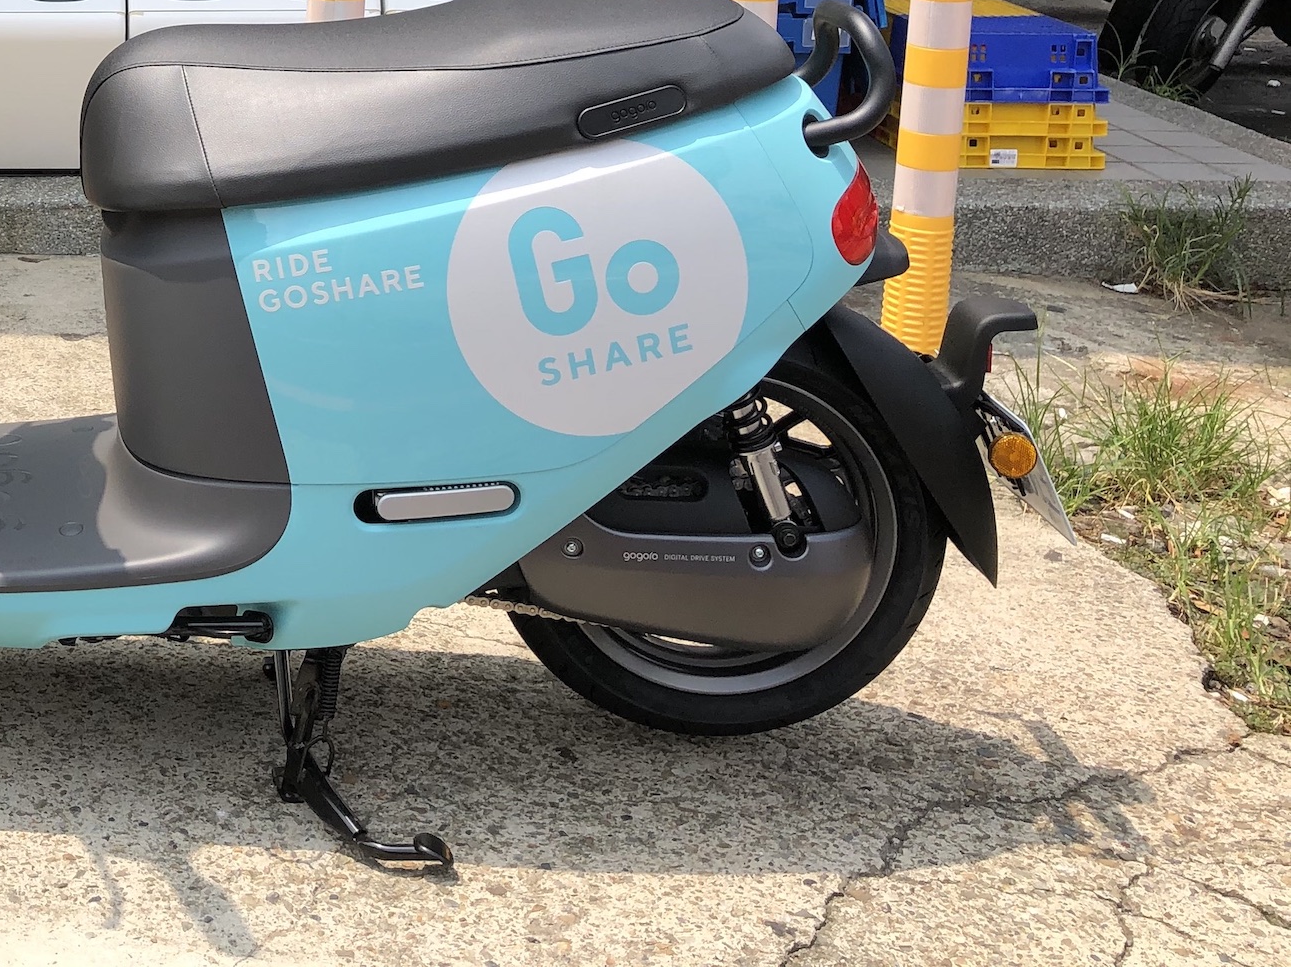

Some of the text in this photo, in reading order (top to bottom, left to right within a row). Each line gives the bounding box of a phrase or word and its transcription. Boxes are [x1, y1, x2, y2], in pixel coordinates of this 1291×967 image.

[611, 100, 657, 123] gogoro
[251, 248, 333, 283] RIDE
[508, 206, 680, 336] Go
[257, 264, 425, 313] GOSHARE
[538, 323, 694, 386] SHARE
[622, 551, 659, 562] gogoro
[690, 554, 709, 562] DRIVE
